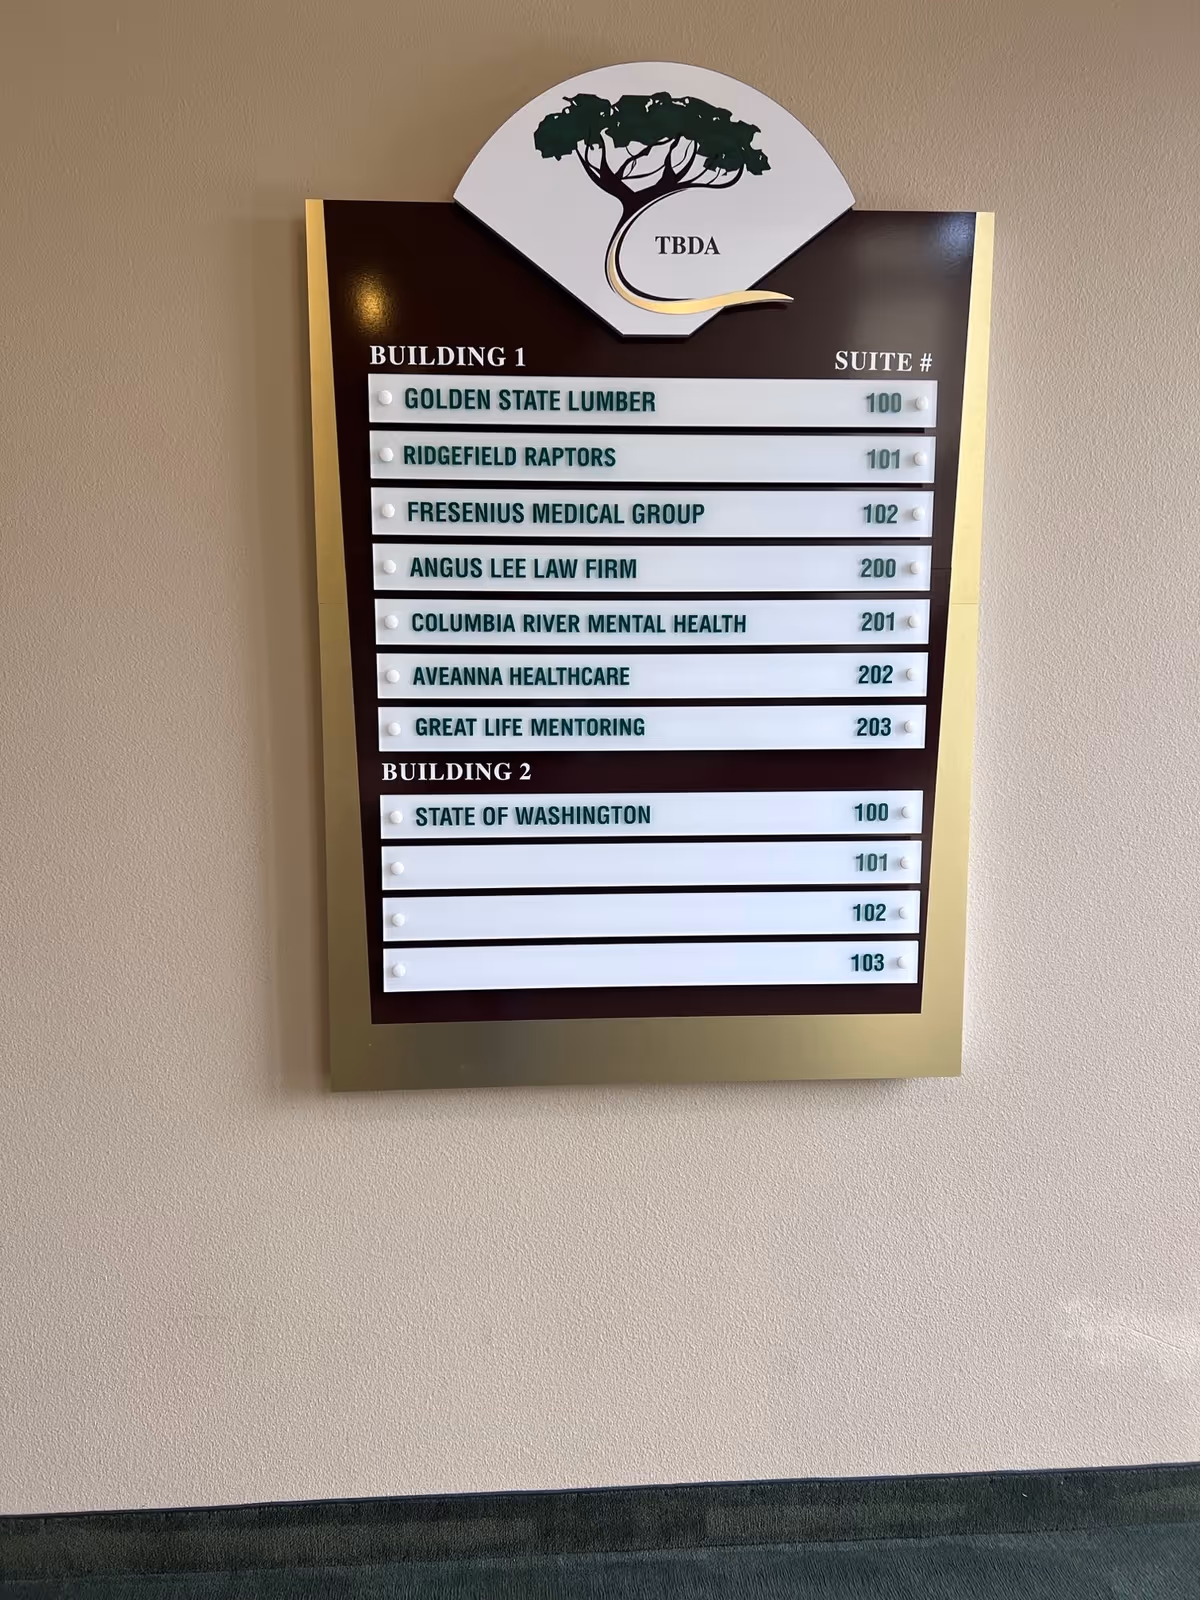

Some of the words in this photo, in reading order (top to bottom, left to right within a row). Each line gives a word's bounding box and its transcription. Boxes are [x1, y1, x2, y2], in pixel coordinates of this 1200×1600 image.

[654, 235, 720, 255] TBDA
[369, 345, 505, 367] BUILDING
[515, 347, 524, 367] 1
[835, 350, 913, 372] SUITE
[919, 352, 933, 372] #
[404, 387, 491, 410] GOLDEN
[498, 389, 561, 411] STATE
[568, 390, 656, 412] LUMBER
[865, 392, 902, 414] 100
[403, 445, 517, 466] RIDGEFIELD
[524, 446, 616, 467] RAPTORS
[866, 448, 900, 470] 101
[407, 501, 525, 524] FRESENIUS
[532, 503, 625, 525] MEDICAL
[632, 503, 705, 525] GROUP
[863, 503, 899, 524] 102
[410, 557, 483, 579] ANGUS
[490, 558, 527, 579] LEE
[534, 558, 578, 579] LAW
[585, 558, 637, 579] FIRM
[860, 557, 897, 579] 200
[411, 612, 516, 633] COLUMBIA
[523, 613, 580, 633] RIVER
[588, 614, 667, 634] MENTAL
[673, 614, 747, 633] HEALTH
[861, 611, 895, 632] 201
[412, 666, 503, 686] AVEANNA
[509, 666, 630, 686] HEALTHCARE
[858, 664, 894, 685] 202
[415, 717, 478, 737] GREAT
[484, 718, 523, 737] LIFE
[530, 717, 645, 737] MENTORING
[856, 717, 892, 737] 203
[381, 762, 512, 781] BUILDING
[519, 762, 532, 780] 2
[415, 806, 476, 827] STATE
[482, 806, 509, 826] OF
[514, 805, 651, 826] WASHINGTON
[854, 802, 889, 822] 100
[855, 853, 888, 872] 101
[852, 903, 887, 922] 102
[851, 953, 885, 972] 103
